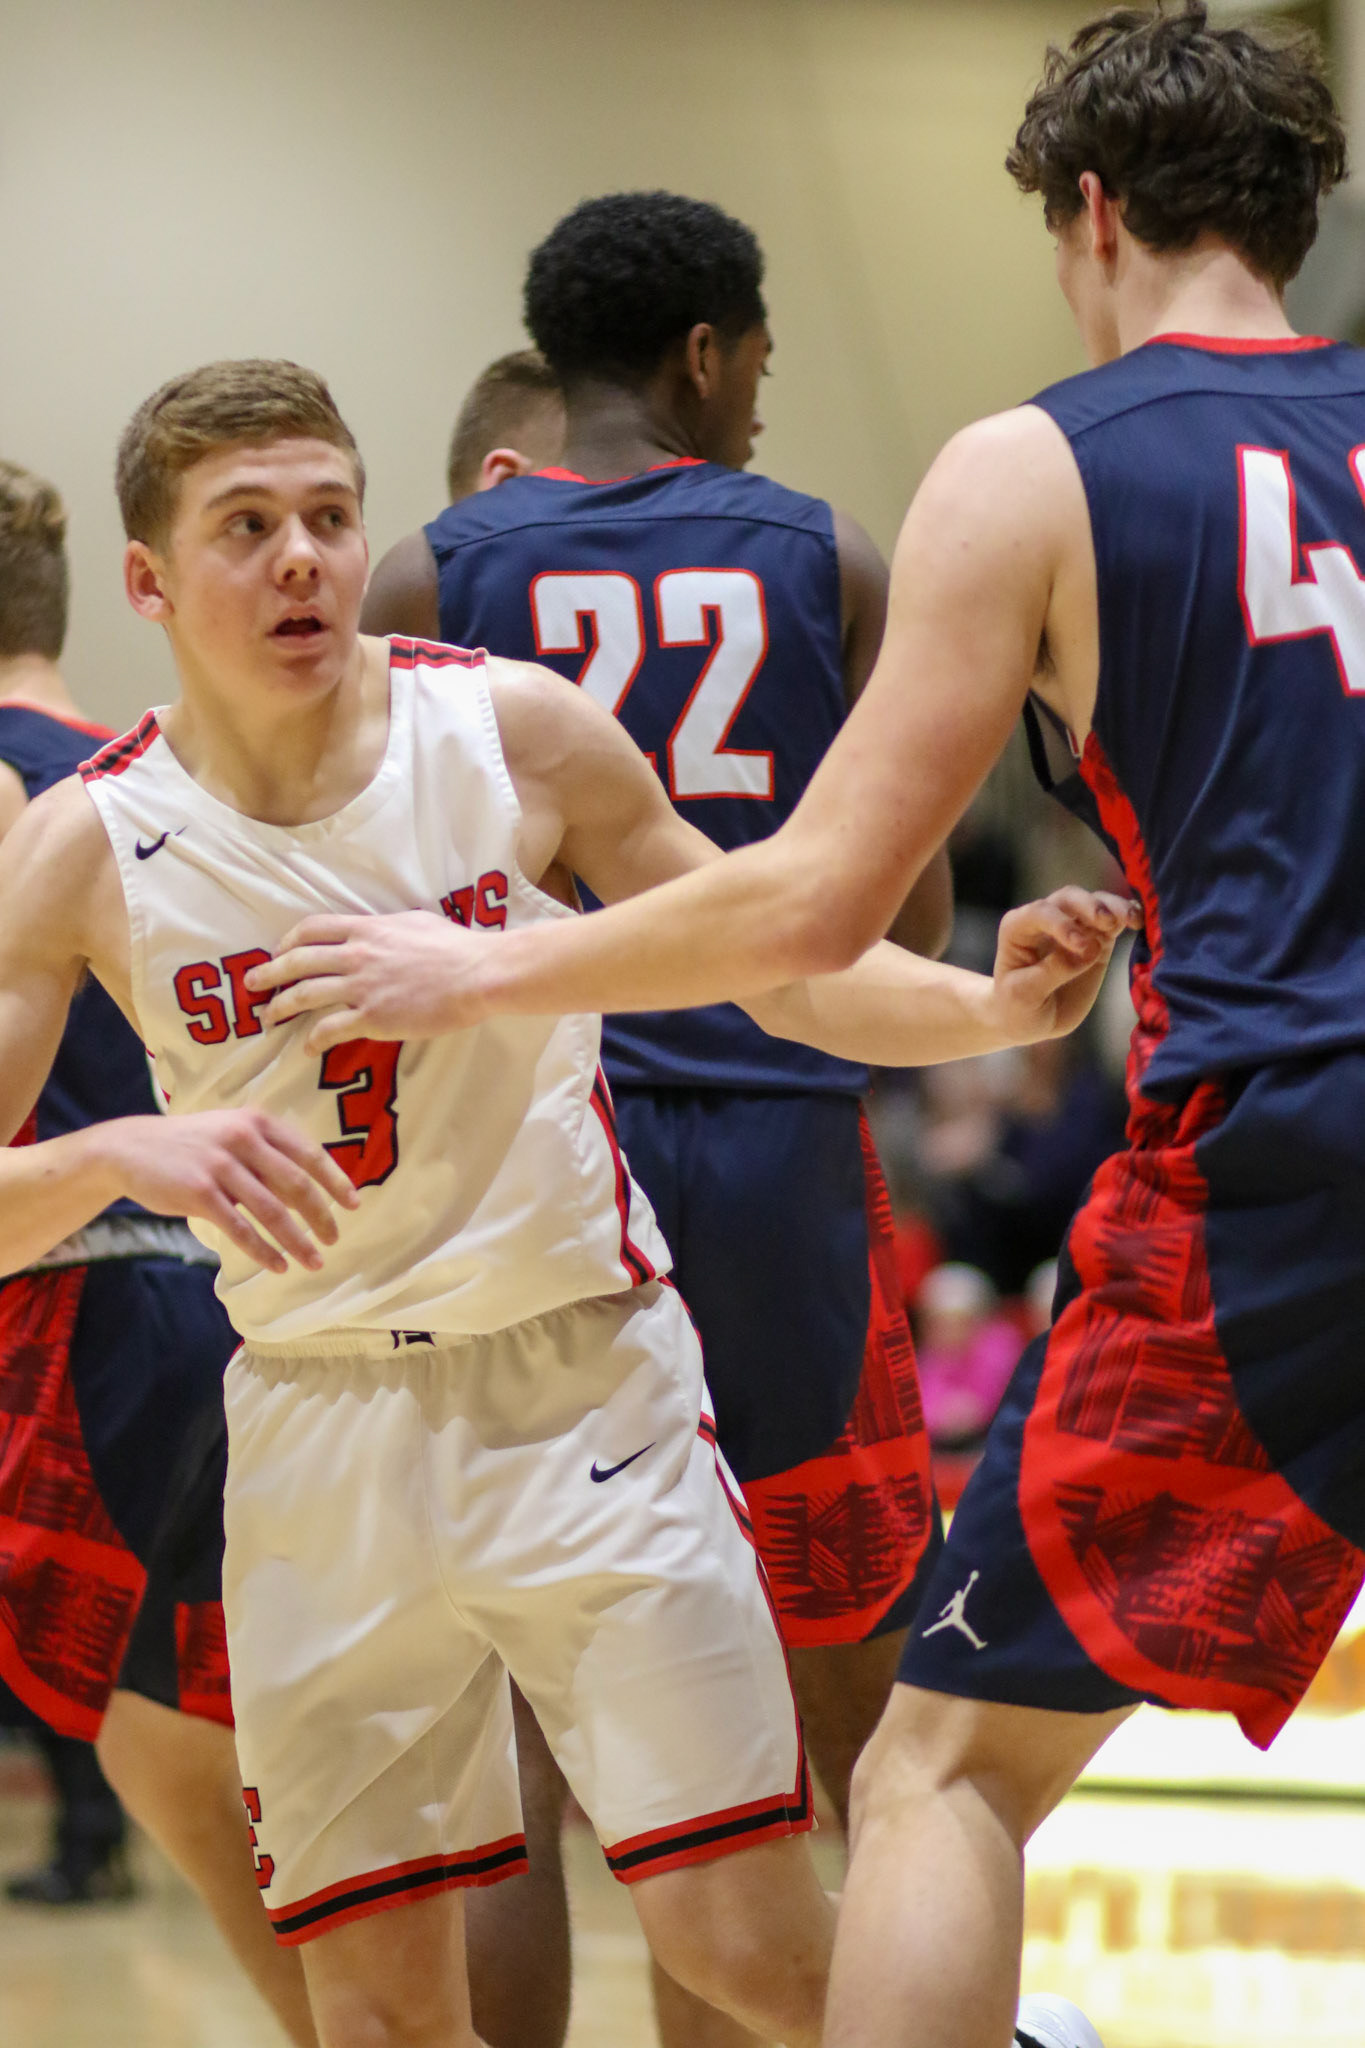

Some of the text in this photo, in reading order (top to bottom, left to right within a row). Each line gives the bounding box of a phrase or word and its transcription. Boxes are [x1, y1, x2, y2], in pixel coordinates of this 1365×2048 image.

[529, 567, 775, 801] 22
[1235, 443, 1365, 697] 4
[318, 1037, 402, 1190] 3
